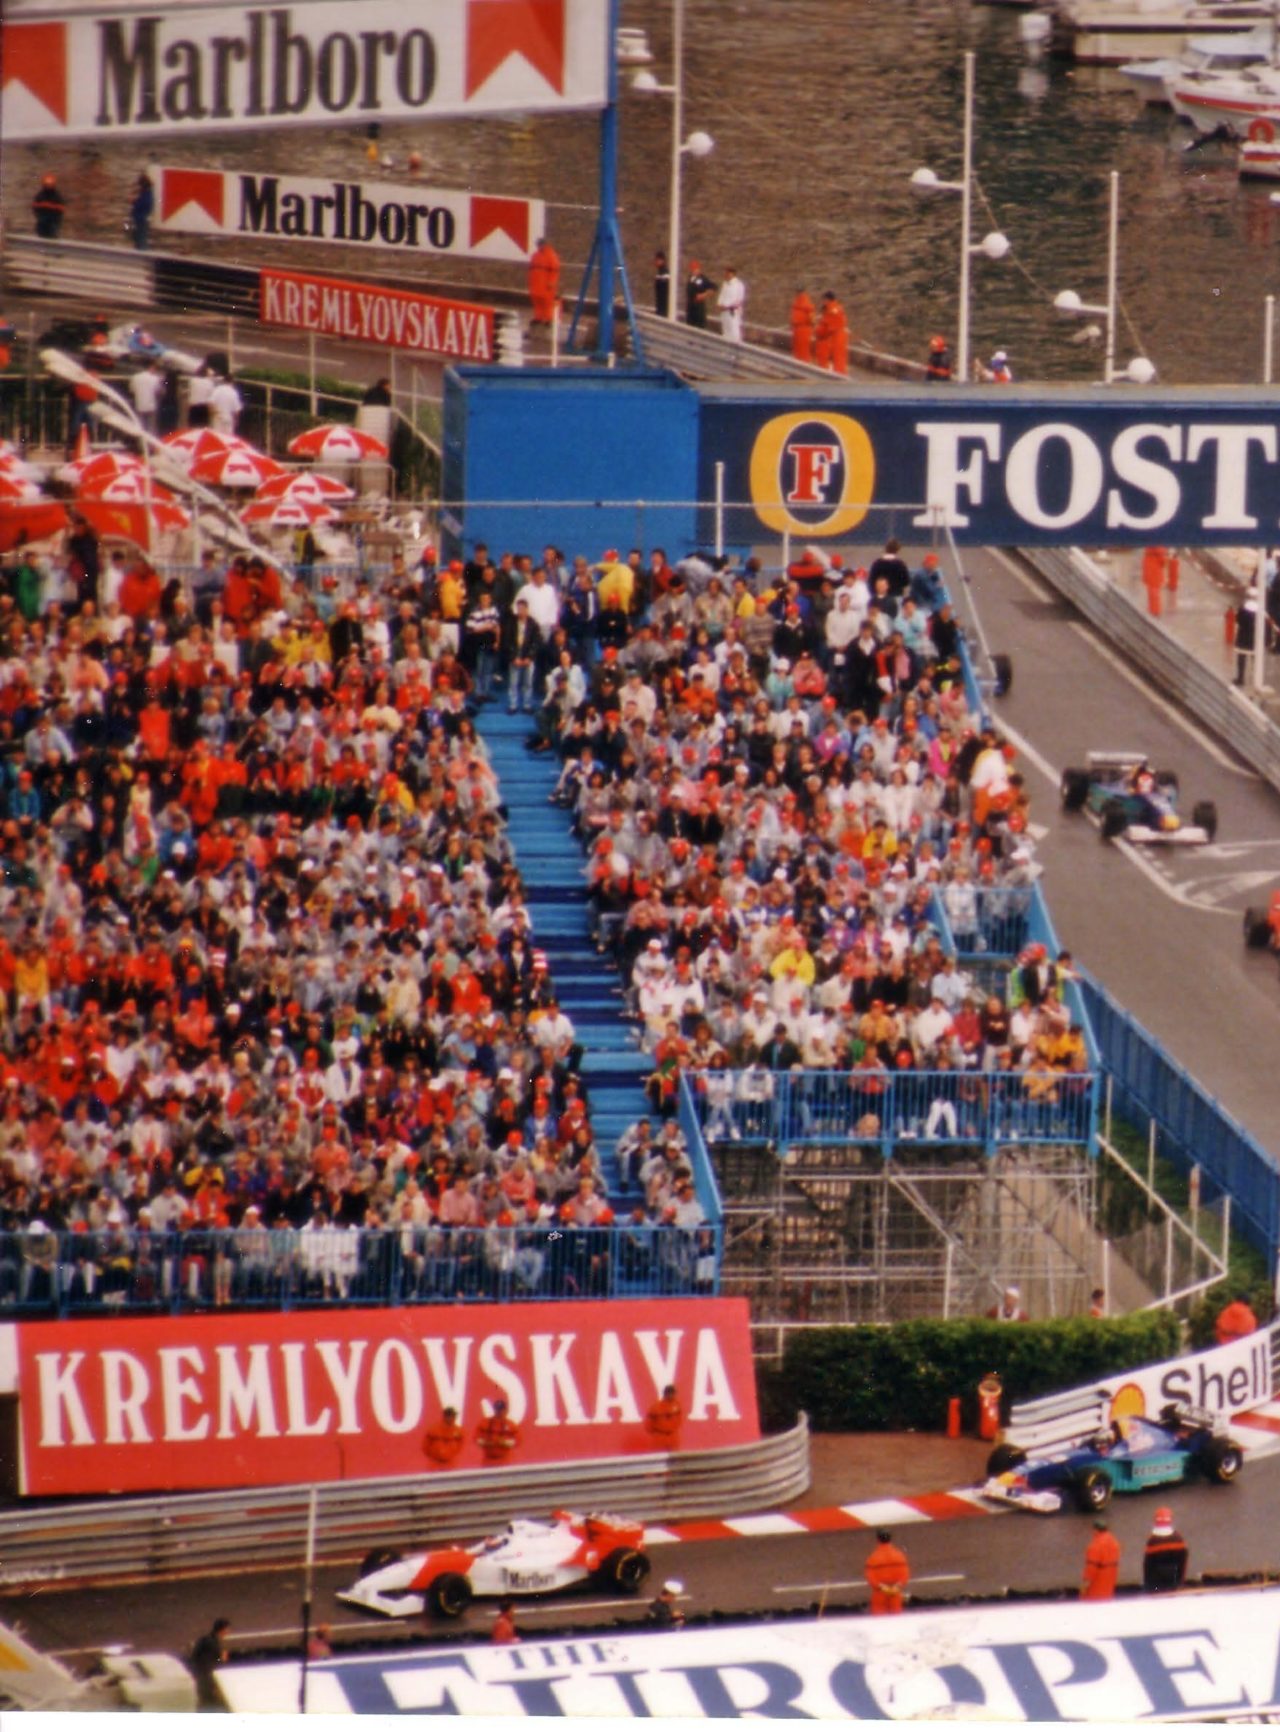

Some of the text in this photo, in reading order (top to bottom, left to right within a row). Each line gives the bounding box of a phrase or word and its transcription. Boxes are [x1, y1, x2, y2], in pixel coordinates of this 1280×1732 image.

[95, 8, 437, 126] Marlboro
[238, 175, 455, 248] Marlboro
[262, 277, 492, 361] KREMLYOVSKAYA
[35, 1328, 741, 1448] KREMLYOVSKAYA
[1160, 1343, 1267, 1410] Shell
[494, 1641, 619, 1670] THE
